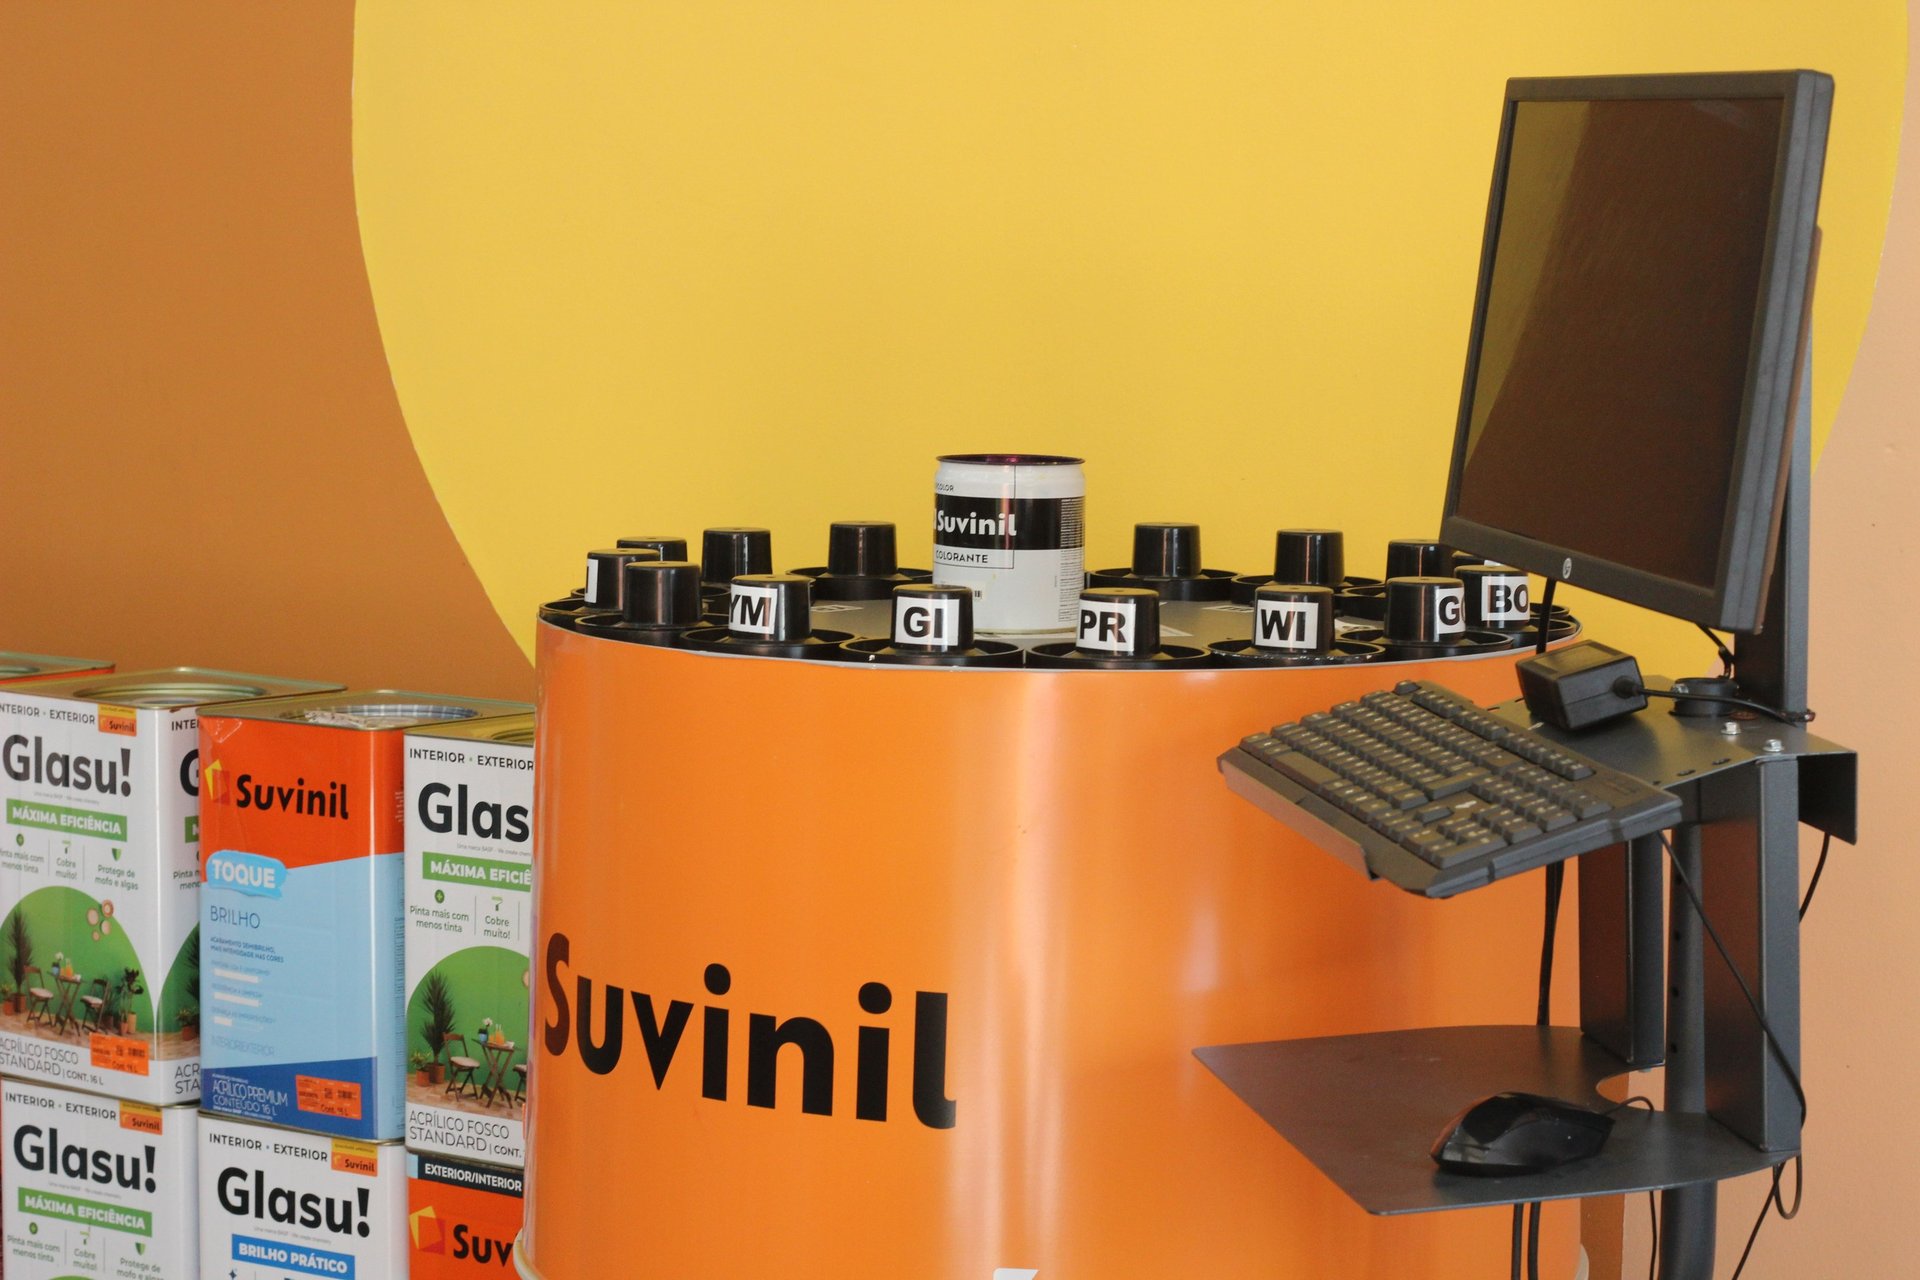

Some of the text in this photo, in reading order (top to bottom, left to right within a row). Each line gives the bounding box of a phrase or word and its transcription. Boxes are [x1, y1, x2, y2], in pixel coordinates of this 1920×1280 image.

[938, 510, 1017, 537] Suvinil
[936, 550, 988, 564] COLORANTE
[730, 594, 772, 626] YM
[1488, 584, 1529, 614] BO
[904, 606, 943, 639] GI
[1080, 609, 1128, 643] PR
[1260, 608, 1306, 642] WI
[50, 710, 96, 725] EXTERIOR
[109, 720, 135, 733] Suvinil
[2, 734, 132, 797] Glasu!
[410, 748, 534, 771] INTERIOR EXTERIOR
[236, 774, 348, 820] Suvinil
[12, 805, 122, 834] MÁXIMA EFICIÊNCIA
[418, 782, 530, 843] Glas
[56, 857, 76, 868] Cobre
[98, 864, 136, 878] Protege de
[212, 858, 276, 889] TOQUE
[430, 859, 532, 886] MÁXIMA EFICIÊ
[94, 876, 112, 886] mofo
[121, 880, 138, 891] algas
[173, 870, 193, 880] Pinta
[210, 905, 260, 929] BRILHO
[410, 904, 470, 922] Pinta mais com
[485, 915, 510, 926] Cobre
[416, 920, 463, 933] menos tinta
[484, 928, 510, 940] muito!
[545, 932, 957, 1130] Suvinil
[44, 1046, 78, 1065] FOSCO
[66, 1070, 89, 1083] CONT.
[90, 1074, 98, 1084] 16
[99, 1076, 104, 1086] L
[174, 1062, 200, 1079] ACR
[175, 1078, 200, 1094] STA
[248, 1086, 288, 1107] PREMIUM
[6, 1092, 54, 1109] INTERIOR
[66, 1102, 116, 1120] EXTERIOR
[262, 1104, 270, 1114] 16
[272, 1106, 278, 1116] L
[132, 1117, 160, 1132] Suvinil
[409, 1110, 510, 1140] ACRÍLICO FOSCO
[209, 1133, 262, 1151] INTERIOR
[274, 1143, 328, 1162] EXTERIOR
[410, 1126, 522, 1158] STANDARD CONT.
[14, 1124, 156, 1194] Glasu!
[344, 1158, 375, 1172] Suvinil
[424, 1163, 522, 1192] EXTERIOR/INTERIOR
[24, 1194, 146, 1230] MÁXIMA EFICIÊNCIA
[217, 1166, 370, 1238] Glasu!
[8, 1234, 60, 1253] Pinta mais com
[13, 1247, 54, 1263] menos tinta
[74, 1248, 96, 1260] Cobre
[453, 1224, 513, 1268] Suv
[73, 1258, 97, 1272] muito!
[120, 1257, 160, 1274] Protege de
[238, 1242, 348, 1274] BRILHO PRÁTICO
